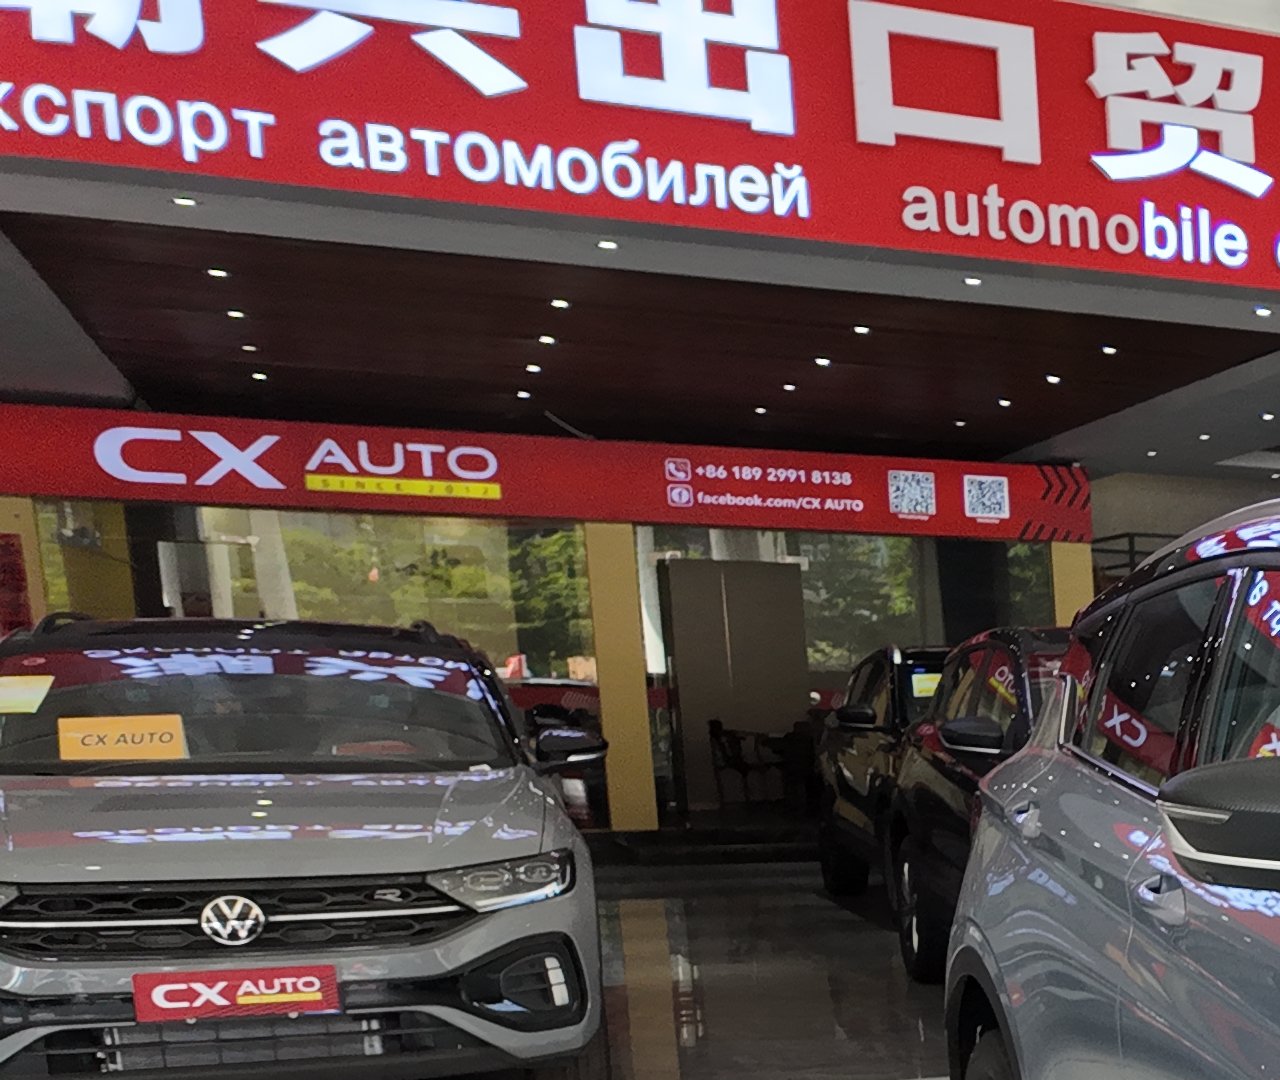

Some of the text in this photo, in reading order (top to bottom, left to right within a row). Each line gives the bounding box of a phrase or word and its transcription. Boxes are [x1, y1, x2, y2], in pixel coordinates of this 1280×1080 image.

[317, 117, 811, 219] автомобилей
[901, 183, 1249, 268] automobile
[93, 426, 498, 489] CX AUTO
[696, 464, 852, 486] +86 189 2991 8138
[697, 492, 864, 512] facebook.com/CX AUTO
[81, 731, 174, 747] CX AUTO
[151, 981, 231, 1009] CX
[237, 976, 321, 995] AUTO
